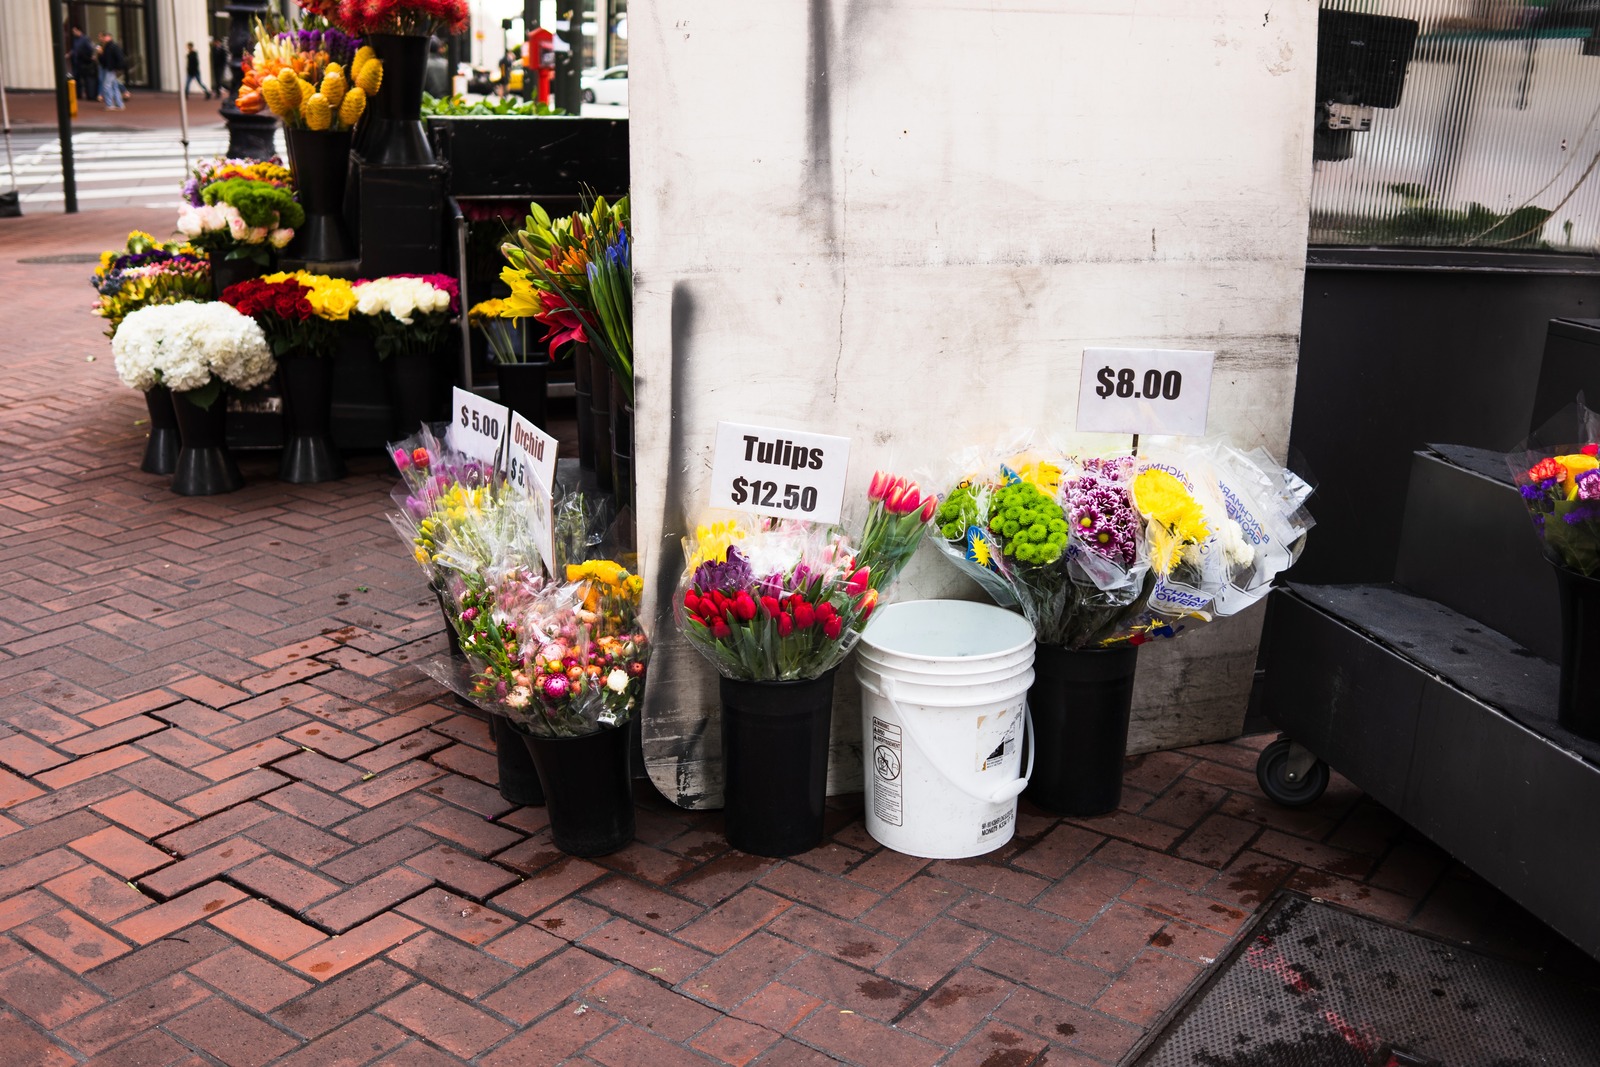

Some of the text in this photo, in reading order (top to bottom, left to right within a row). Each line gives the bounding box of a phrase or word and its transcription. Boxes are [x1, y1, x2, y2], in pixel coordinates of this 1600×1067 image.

[1096, 366, 1182, 400] $8.00
[515, 421, 545, 463] Orchid
[743, 435, 824, 470] Tulips
[731, 476, 818, 512] $12.50
